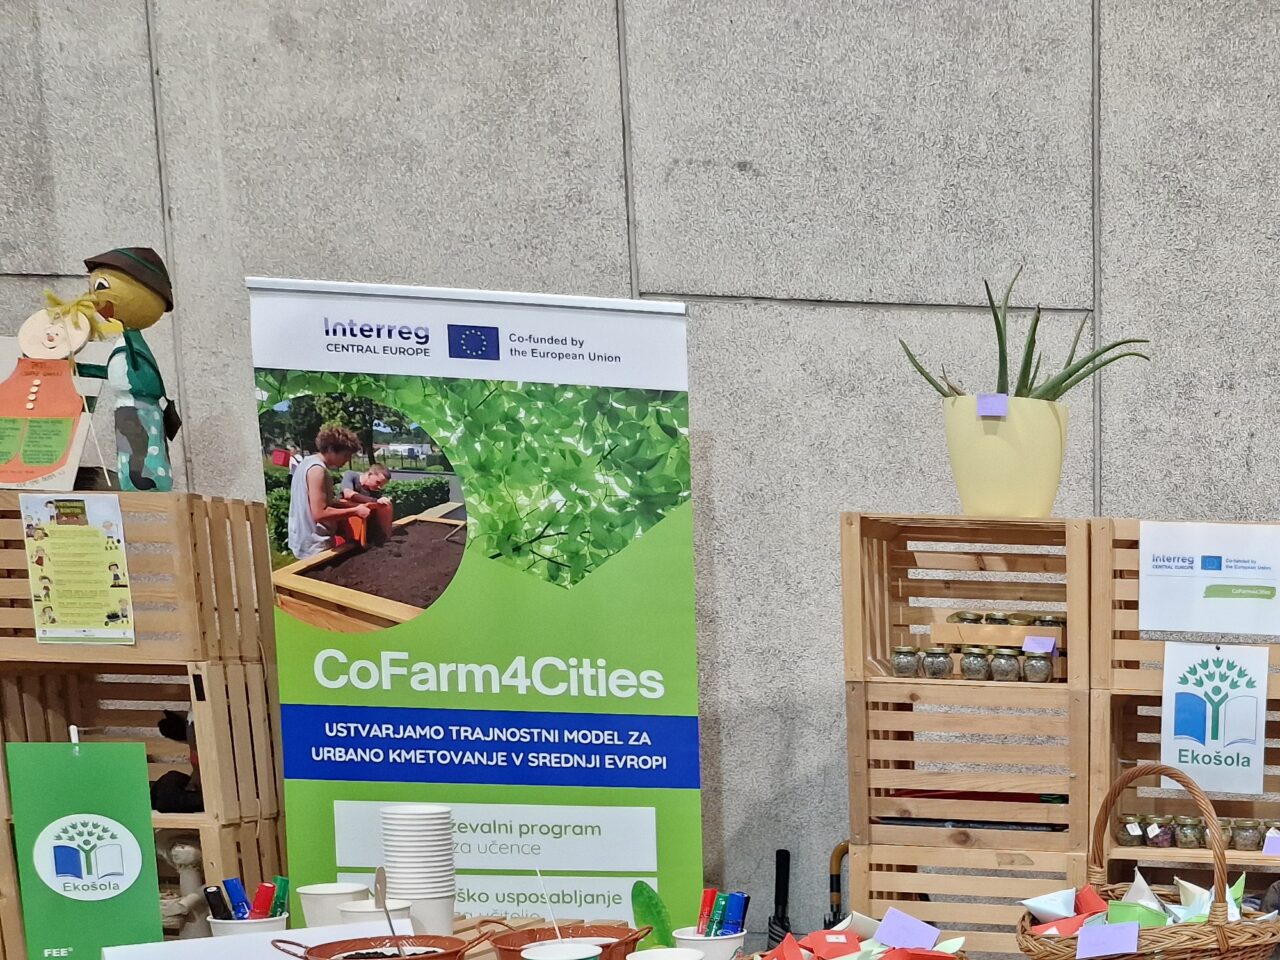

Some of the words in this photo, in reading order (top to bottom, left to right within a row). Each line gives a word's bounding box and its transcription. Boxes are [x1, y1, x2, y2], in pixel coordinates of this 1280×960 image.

[324, 316, 430, 345] Interreg
[509, 332, 568, 347] Co-funded
[571, 336, 585, 348] by
[326, 343, 380, 355] CENTRAL
[382, 345, 430, 357] EUROPE
[509, 347, 527, 359] the
[531, 348, 585, 363] European
[588, 352, 622, 363] Union
[313, 648, 666, 700] CoFarm4Cities
[325, 721, 445, 741] USTVARJAMO
[448, 725, 560, 744] TRAJNOSTNI
[563, 729, 624, 746] MODEL
[628, 730, 652, 747] ZA
[311, 746, 384, 763] URBANO
[388, 749, 508, 767] KMETOVANJE
[511, 752, 524, 766] V
[528, 752, 601, 769] SREDNJI
[604, 754, 668, 770] EVROPI
[1178, 748, 1251, 768] Ekošola
[519, 822, 602, 839] program
[477, 841, 541, 856] učence
[63, 881, 121, 893] Ekošola
[495, 889, 623, 908] usposabljanje
